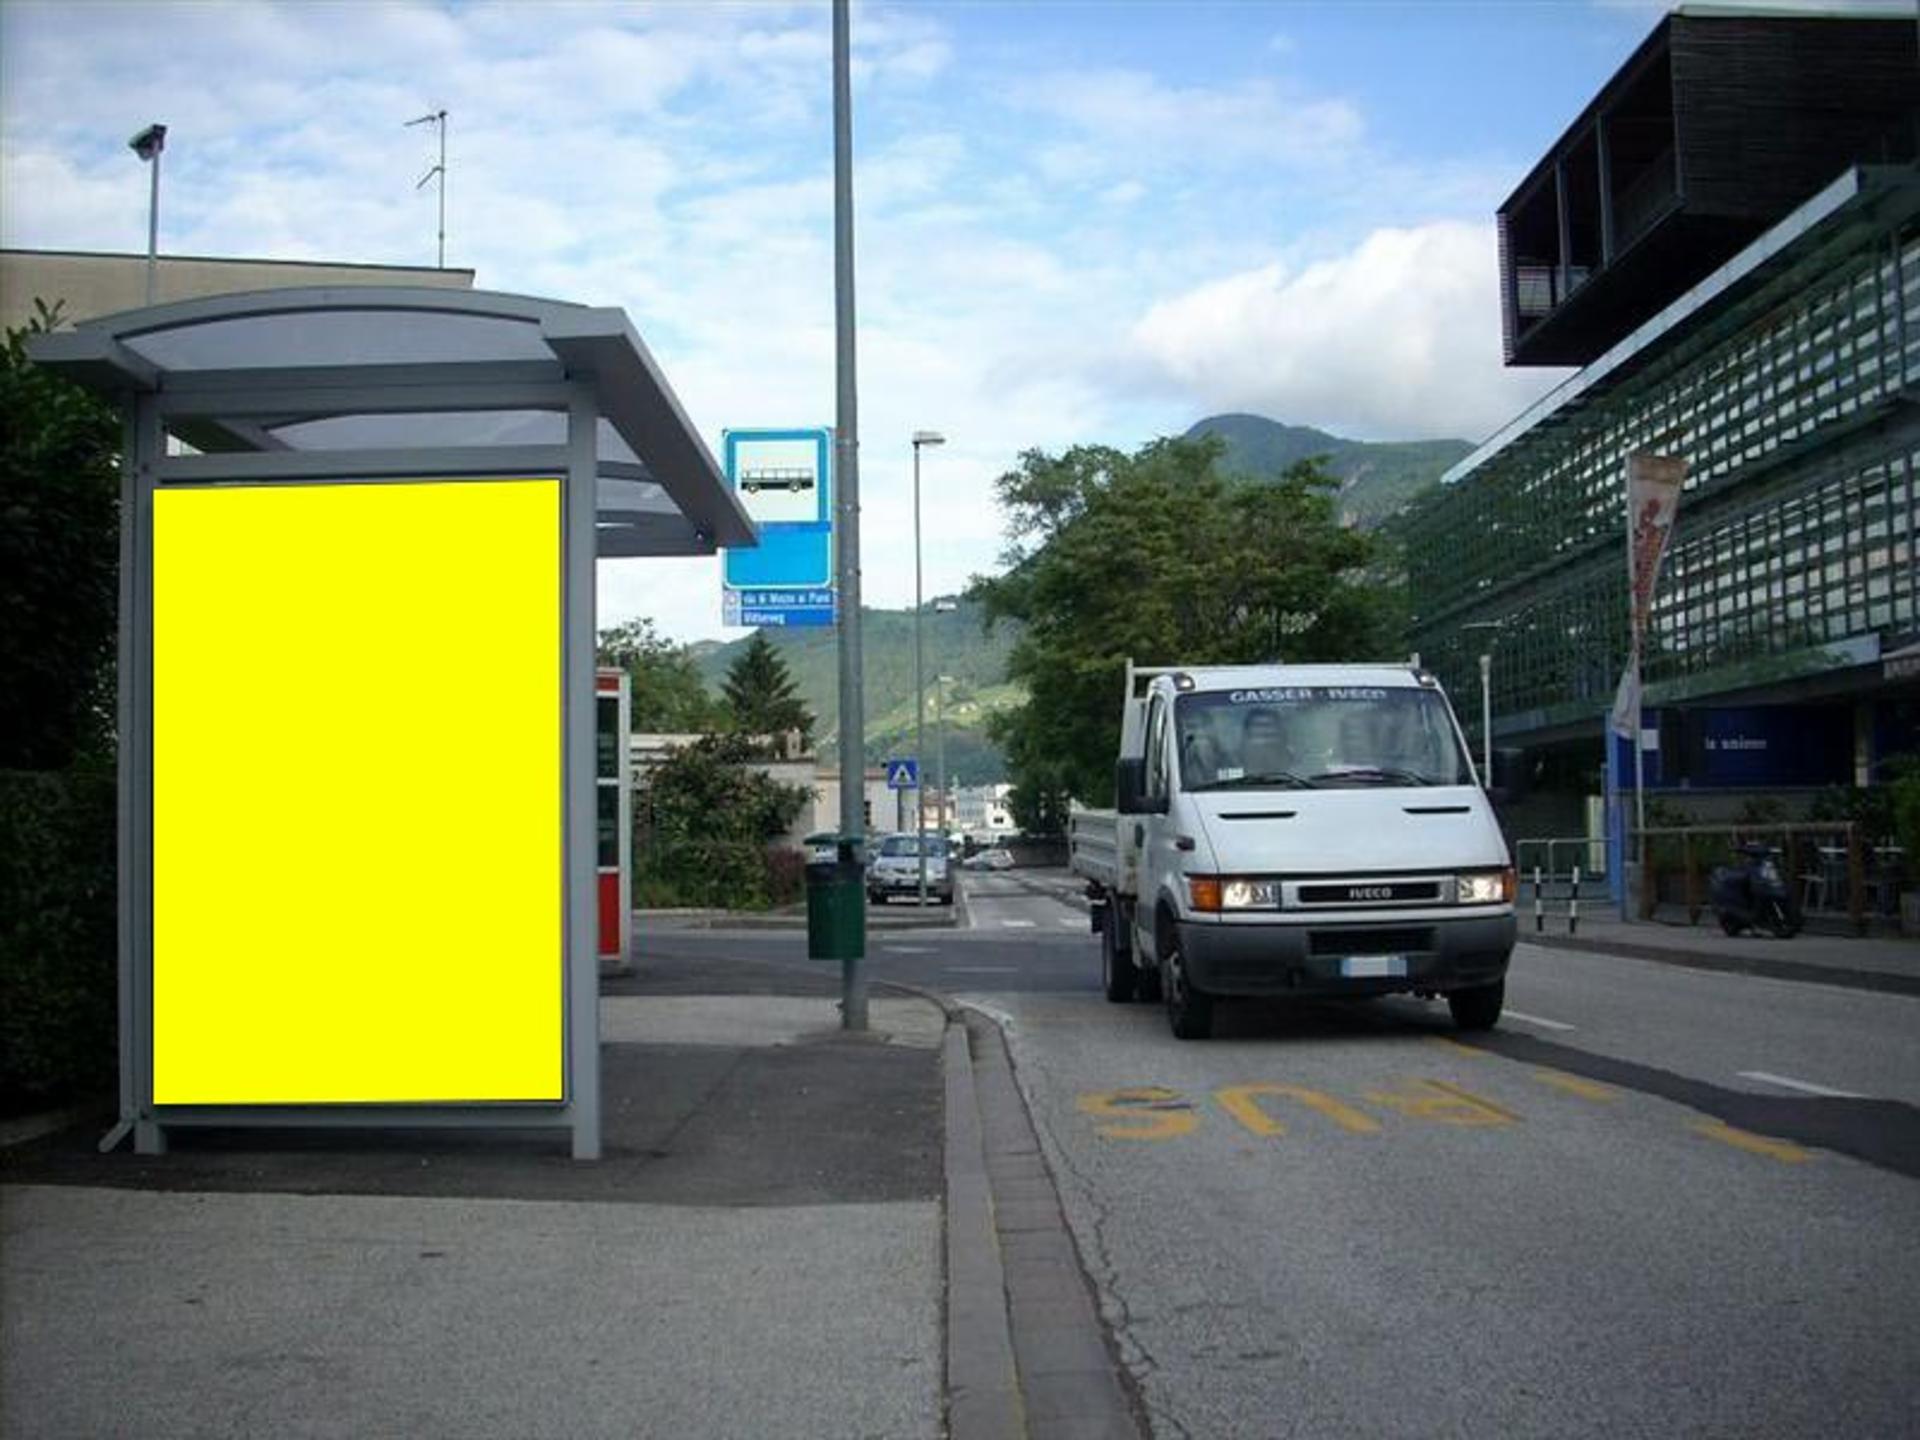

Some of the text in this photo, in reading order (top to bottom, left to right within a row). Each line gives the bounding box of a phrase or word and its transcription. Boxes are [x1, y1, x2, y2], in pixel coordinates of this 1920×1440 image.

[1229, 688, 1387, 703] GASSER IVECO
[1349, 886, 1393, 900] IVECO
